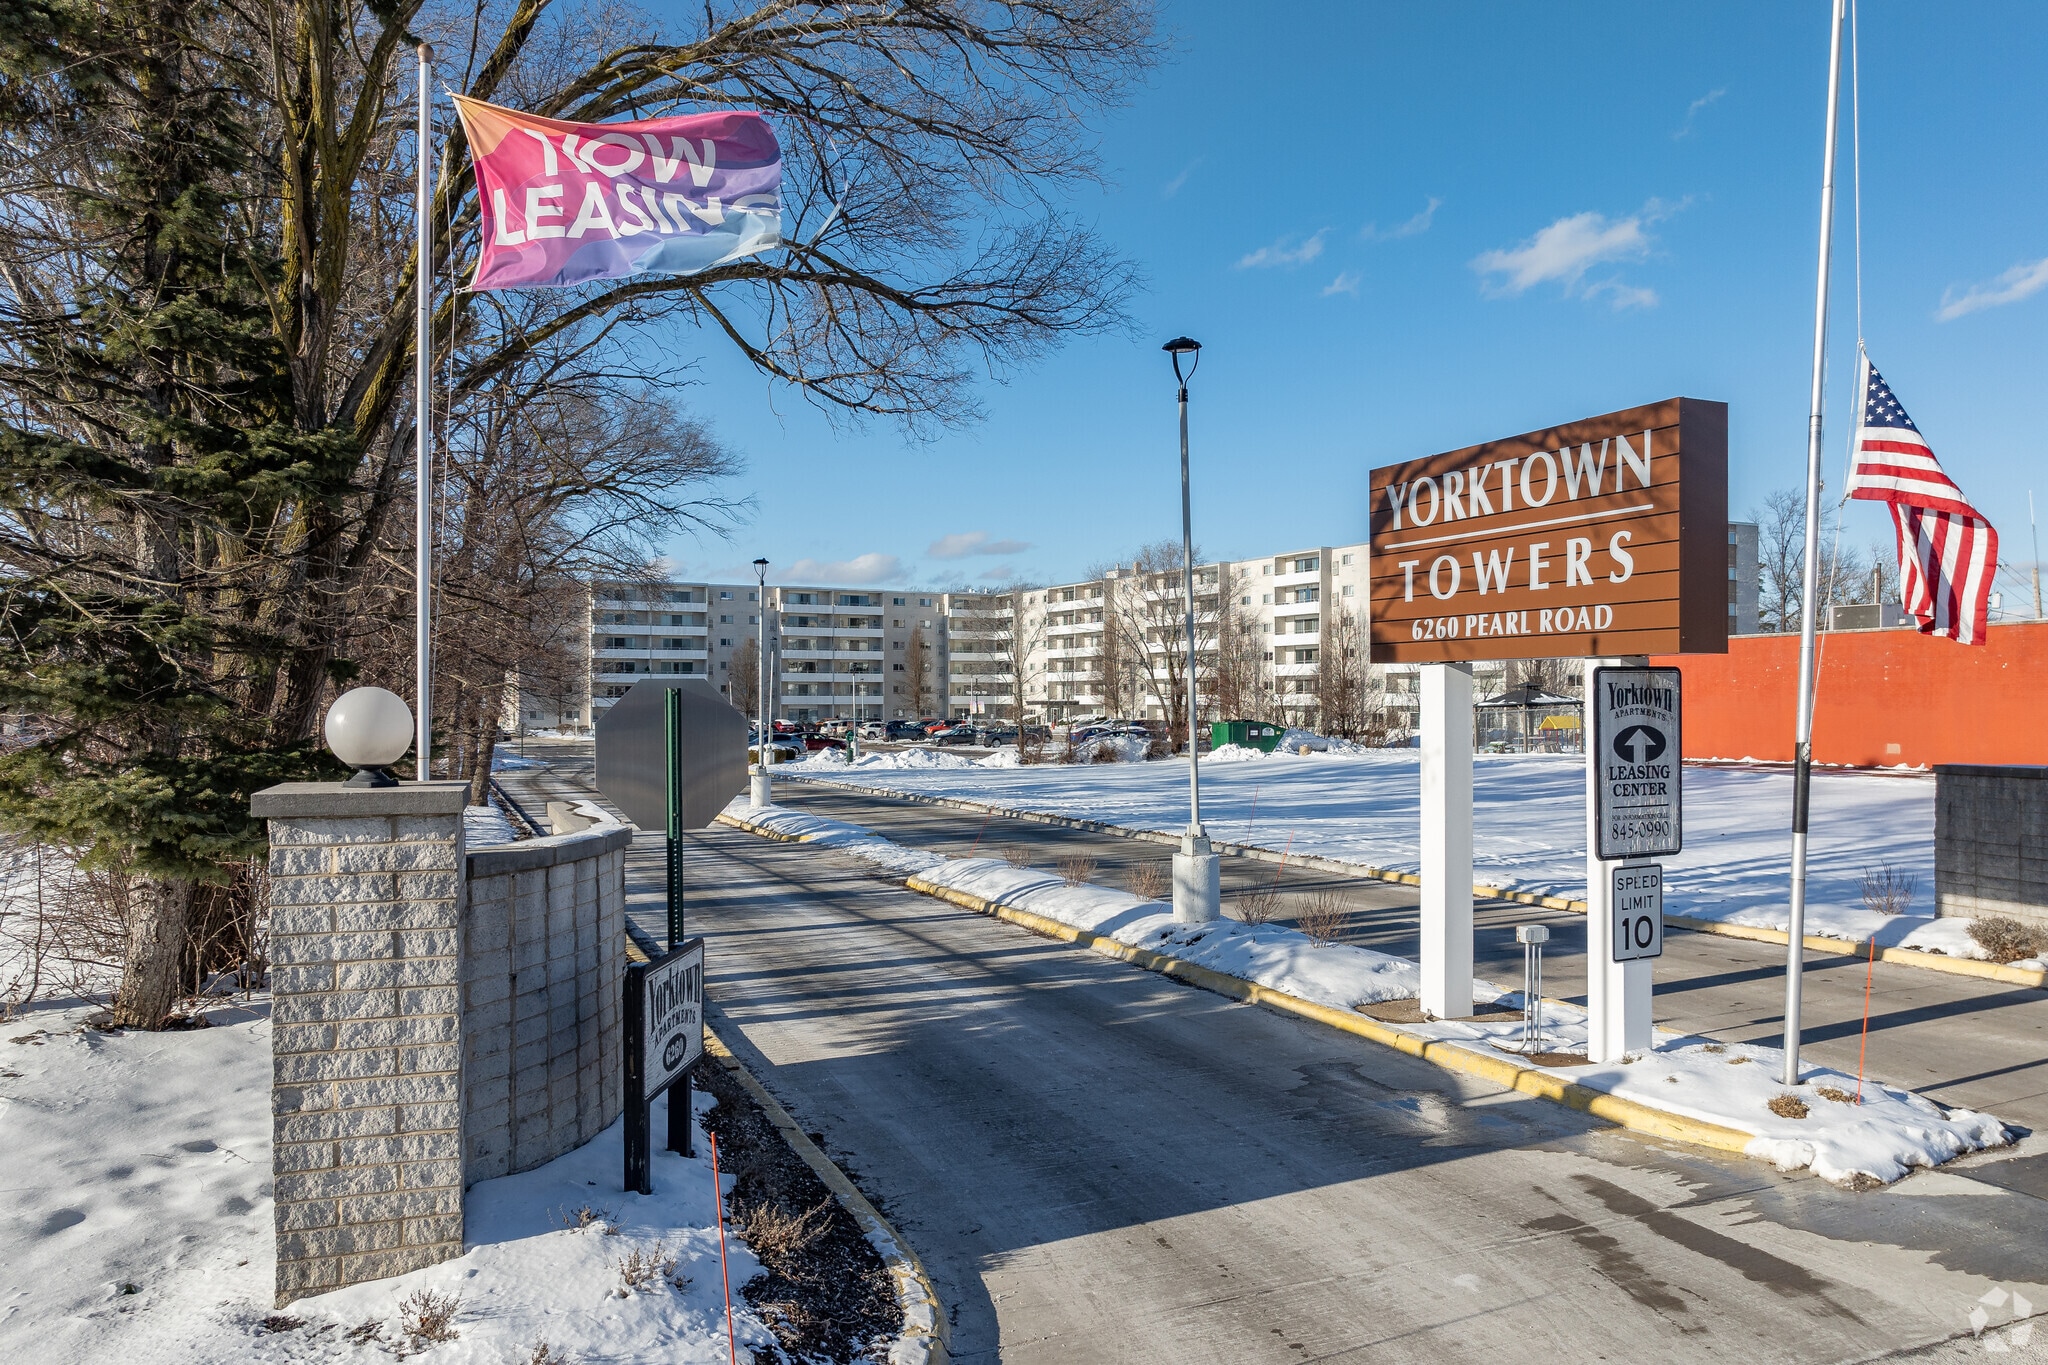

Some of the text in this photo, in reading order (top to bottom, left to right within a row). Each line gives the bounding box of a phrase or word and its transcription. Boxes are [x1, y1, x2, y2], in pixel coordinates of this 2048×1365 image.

[1385, 429, 1652, 531] YORKTOWN
[1398, 530, 1634, 603] TOWERS
[1411, 604, 1613, 641] 6260 PEARL ROAD
[1607, 682, 1672, 712] Yorktown
[1614, 707, 1667, 722] APARTMENTS
[1609, 764, 1670, 781] LEASING
[1613, 781, 1667, 798] CENTER
[1611, 820, 1669, 840] 845-0990
[1617, 874, 1659, 891] SPEED
[1621, 895, 1654, 911] LIMIT
[1622, 914, 1653, 951] 10
[648, 962, 701, 1036] Yorktown
[654, 1009, 697, 1049] APARTMENTS
[665, 1037, 684, 1066] 6260
